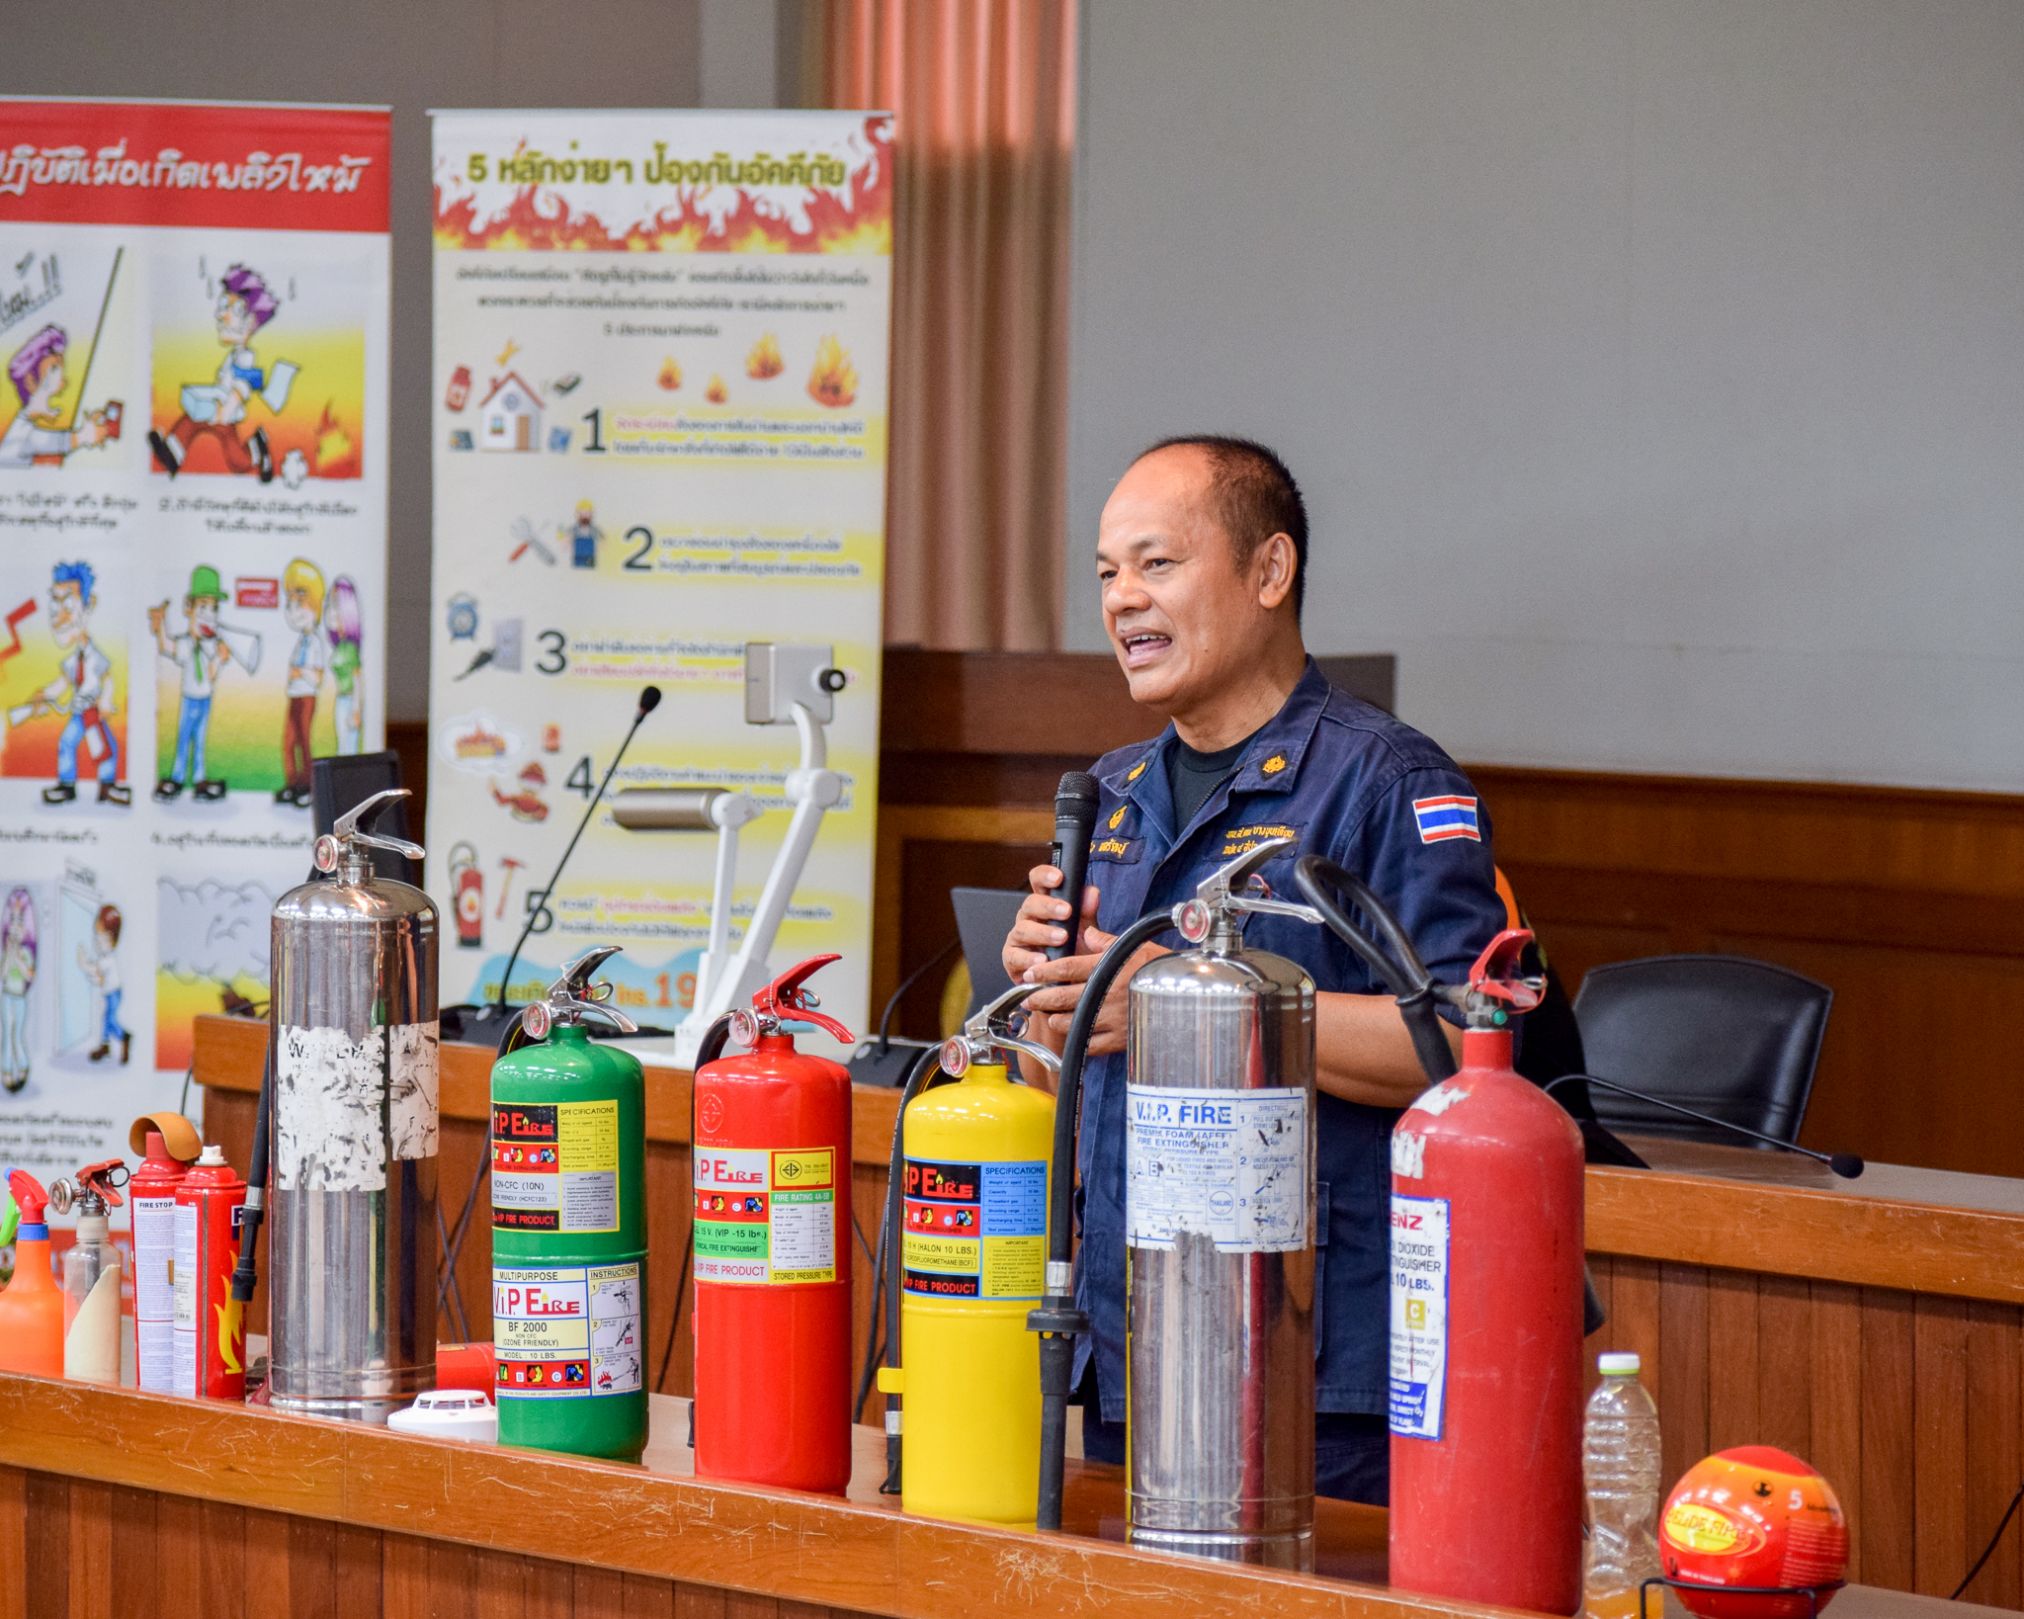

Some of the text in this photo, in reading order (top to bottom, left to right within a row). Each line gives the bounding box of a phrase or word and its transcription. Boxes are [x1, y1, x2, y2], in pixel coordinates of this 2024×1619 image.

[467, 153, 488, 183] 5
[644, 141, 846, 186] ป้องกันอัคคีภัย
[582, 408, 606, 453] 1
[623, 527, 654, 571] 2
[534, 630, 567, 674] 3
[565, 756, 595, 800] 4
[525, 890, 554, 932] 5
[1181, 1105, 1232, 1124] FIRE
[1240, 1115, 1246, 1123] 1
[1165, 1130, 1194, 1139] FOAM
[1137, 1137, 1152, 1146] FIRE
[1239, 1156, 1248, 1166] 2
[1239, 1198, 1247, 1207] 3
[1391, 1211, 1423, 1231] ENZ
[945, 1245, 953, 1253] 10
[500, 1271, 558, 1281] MULTIPURPOSE
[590, 1266, 638, 1278] INSTRUCTIONS
[721, 1265, 765, 1276] PRODUCT
[931, 1281, 976, 1294] PRODUCT
[1409, 1302, 1420, 1319] C
[508, 1321, 548, 1333] BF 2000
[523, 1339, 559, 1348] FRIENDLY)
[1788, 1490, 1803, 1511] 5
